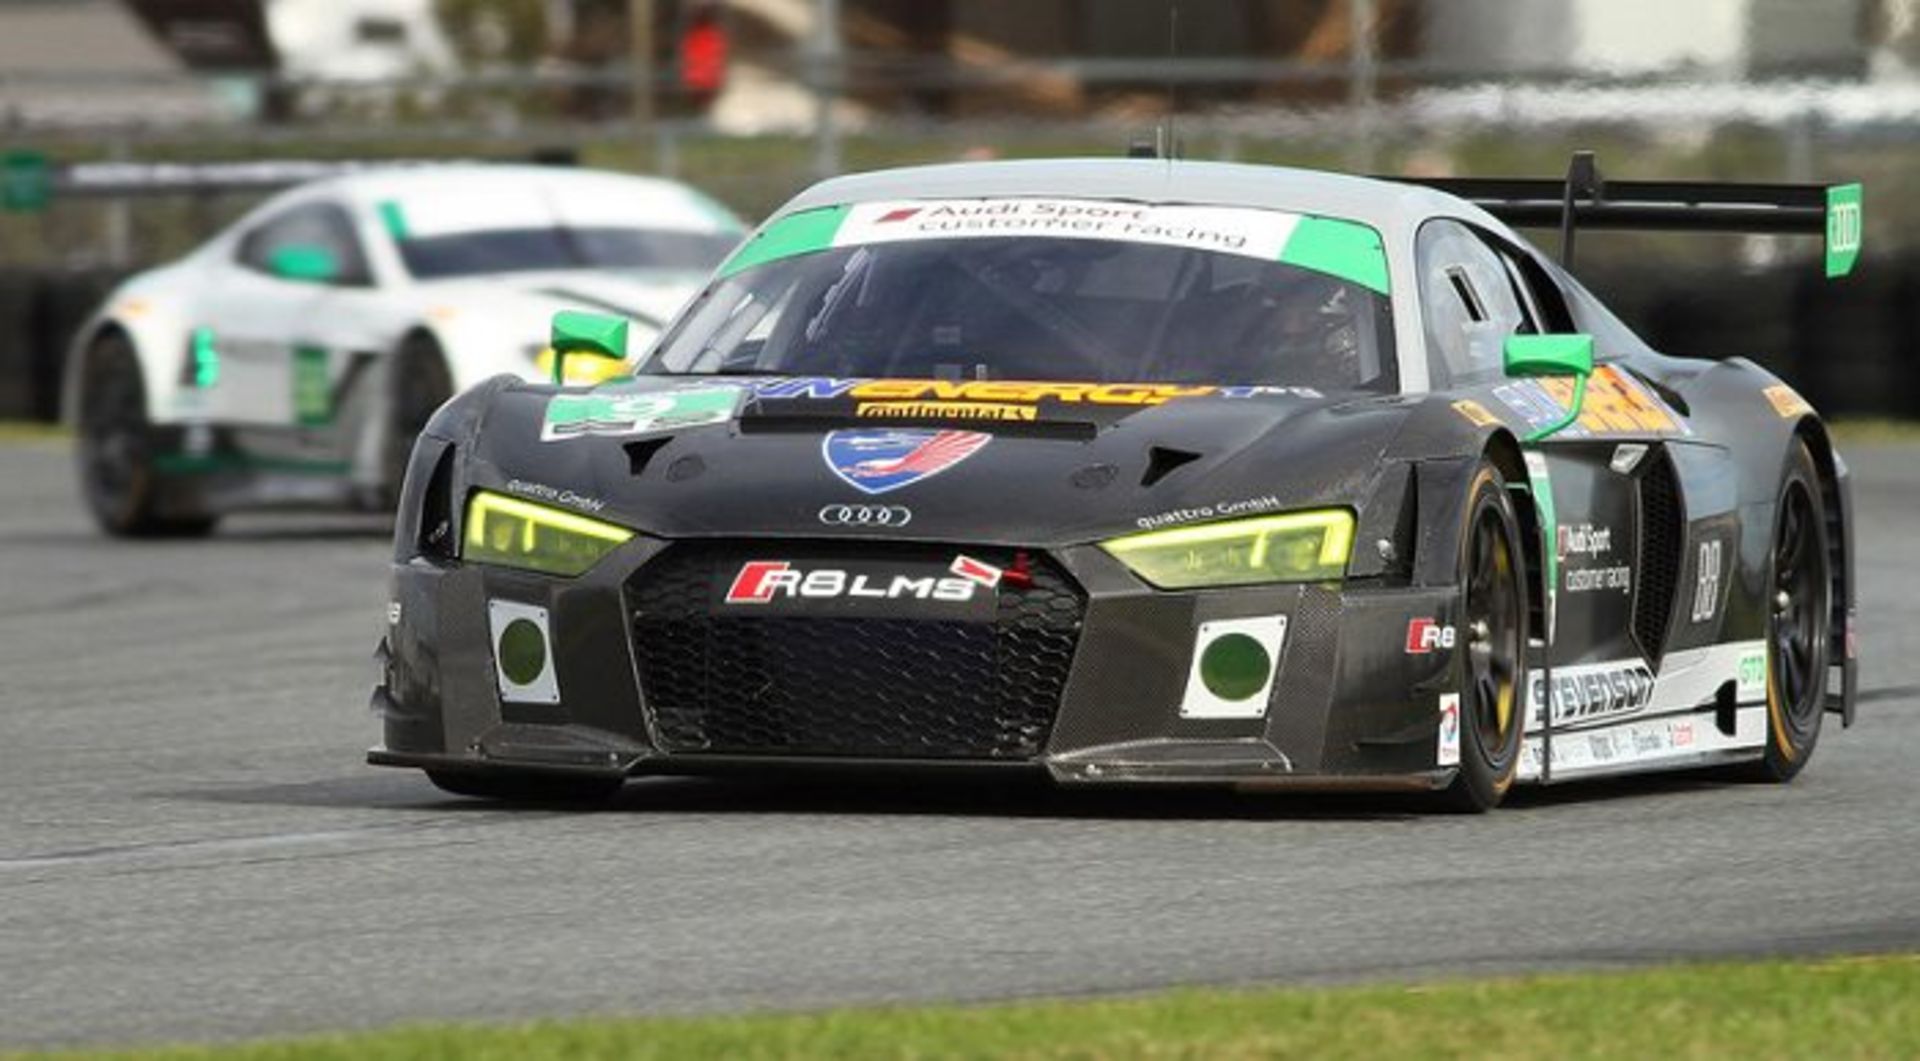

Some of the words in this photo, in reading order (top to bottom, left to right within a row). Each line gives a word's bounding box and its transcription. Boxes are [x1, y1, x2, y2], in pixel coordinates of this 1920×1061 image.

[929, 203, 1020, 217] Audi
[1035, 204, 1147, 220] Sport
[918, 217, 1104, 233] customer
[1124, 221, 1248, 249] racing
[1136, 505, 1214, 530] quattro
[1216, 495, 1280, 514] GmbH
[1420, 625, 1456, 649] R8
[1533, 665, 1655, 723] STEVENSON
